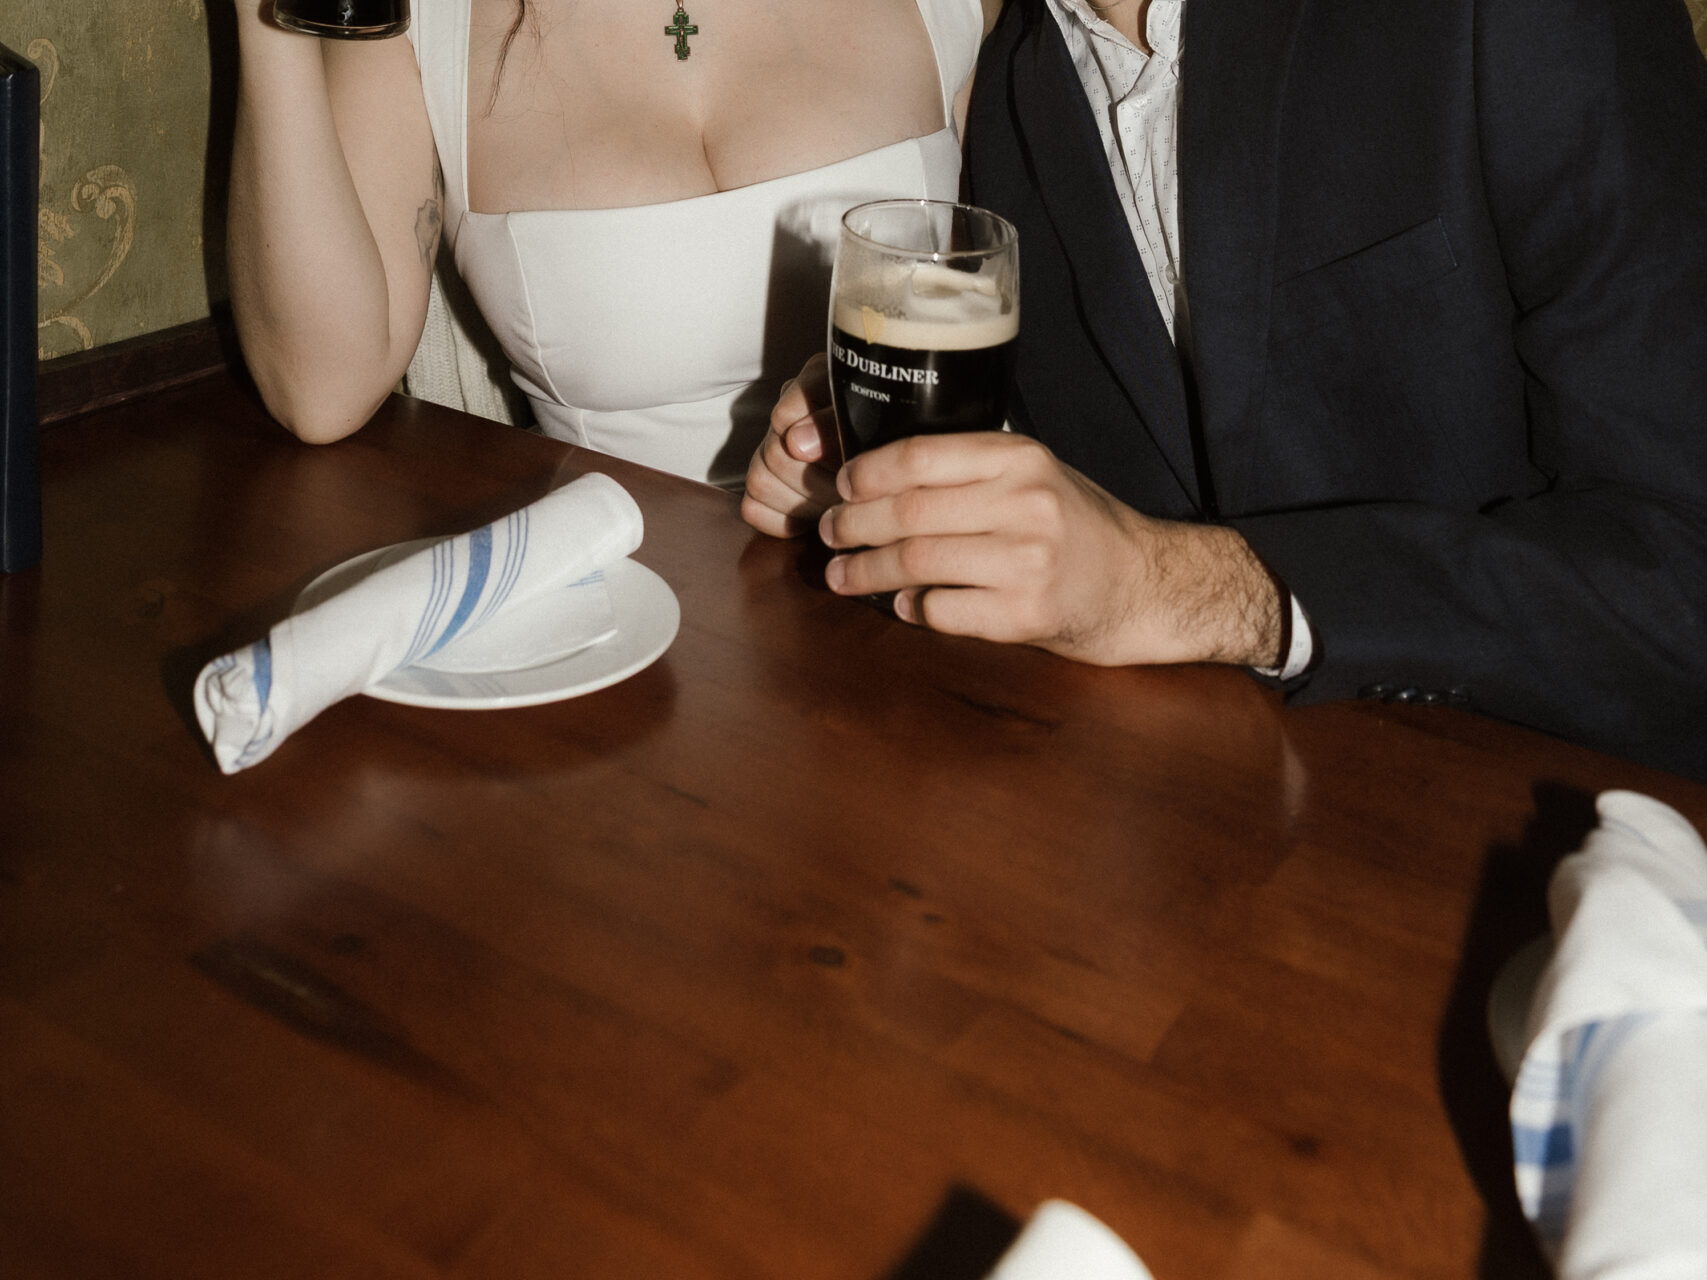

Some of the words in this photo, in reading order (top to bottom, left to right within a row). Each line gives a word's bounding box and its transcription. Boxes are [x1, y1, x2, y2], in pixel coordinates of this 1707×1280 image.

[831, 342, 845, 362] HE
[847, 350, 939, 385] DUBLINER
[851, 382, 890, 403] BOSTON
